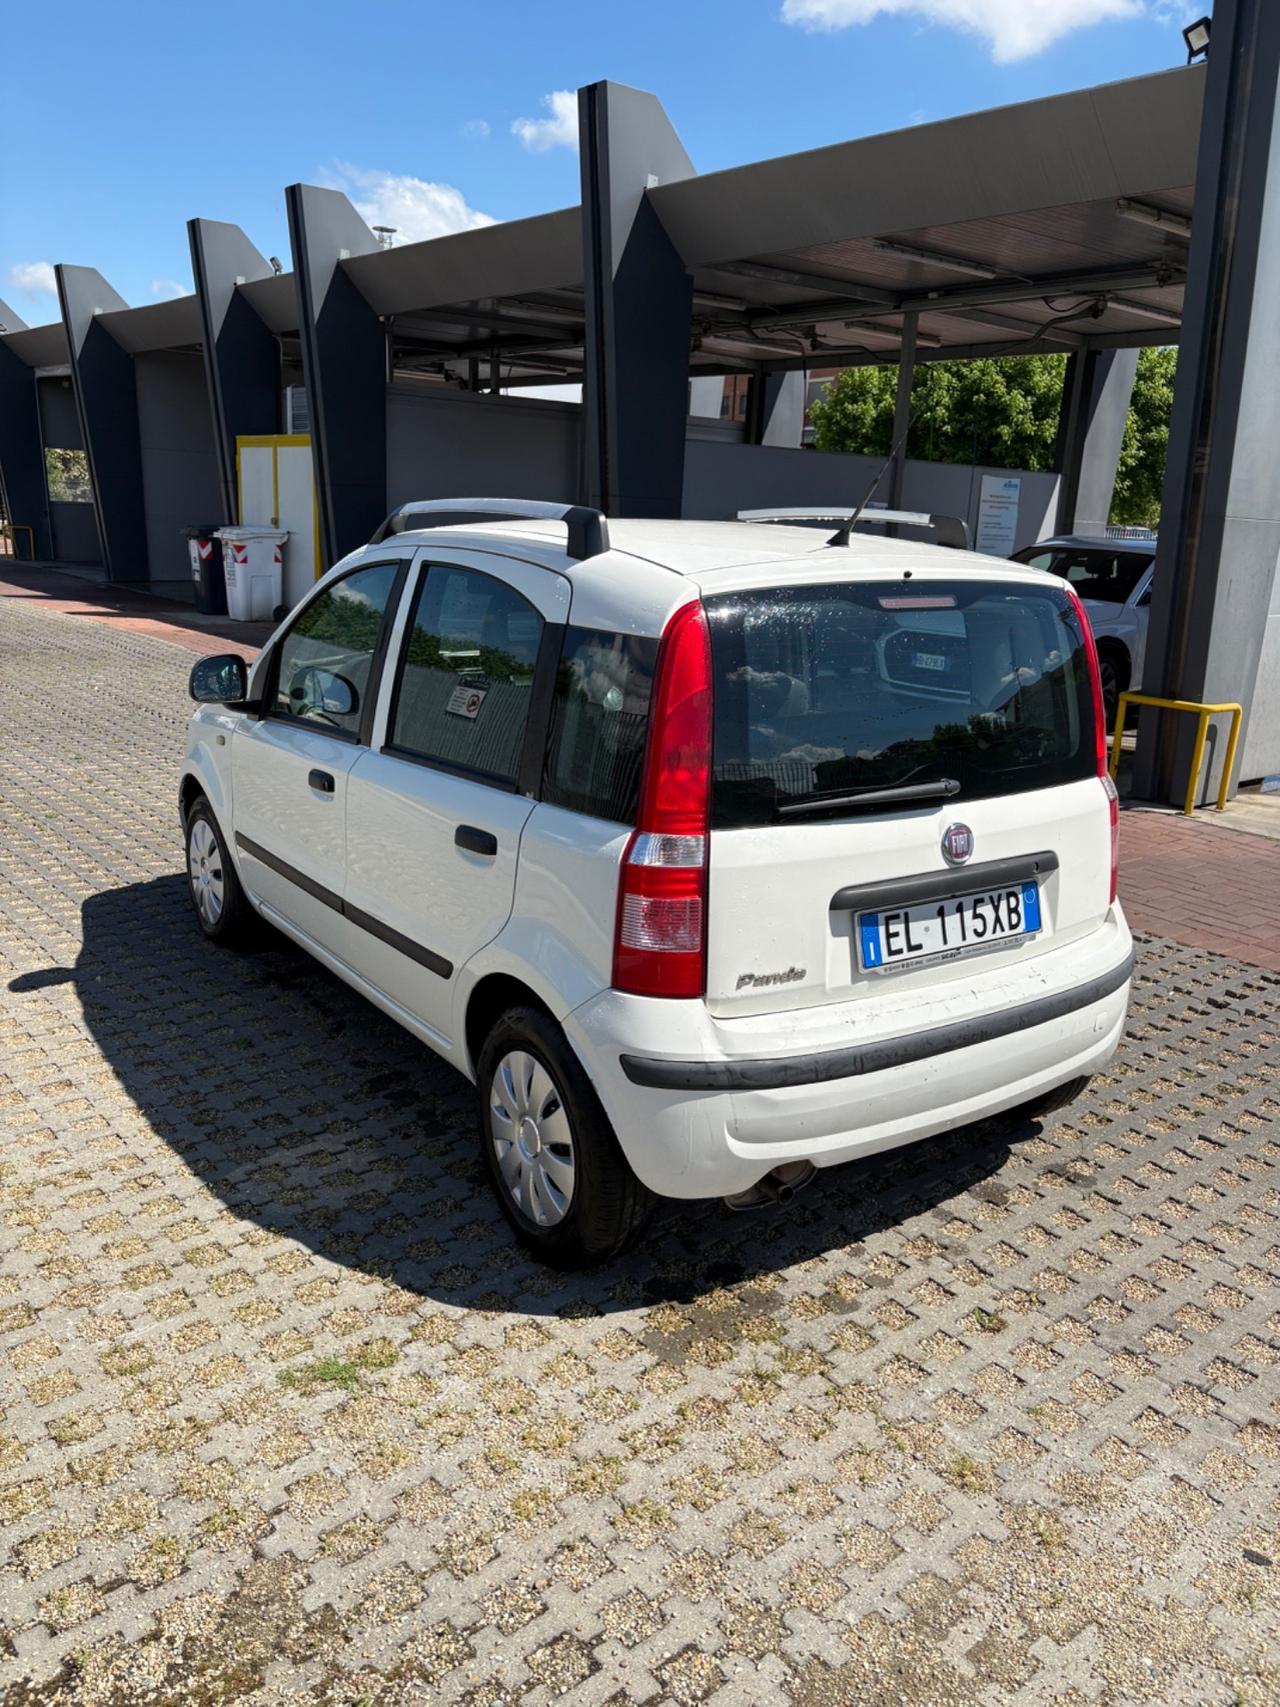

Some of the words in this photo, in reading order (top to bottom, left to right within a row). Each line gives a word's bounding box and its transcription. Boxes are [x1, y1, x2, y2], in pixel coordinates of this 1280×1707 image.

[951, 833, 969, 853] FIAT
[884, 911, 923, 957] EL
[936, 891, 1022, 946] 115XB
[735, 966, 807, 991] Panda
